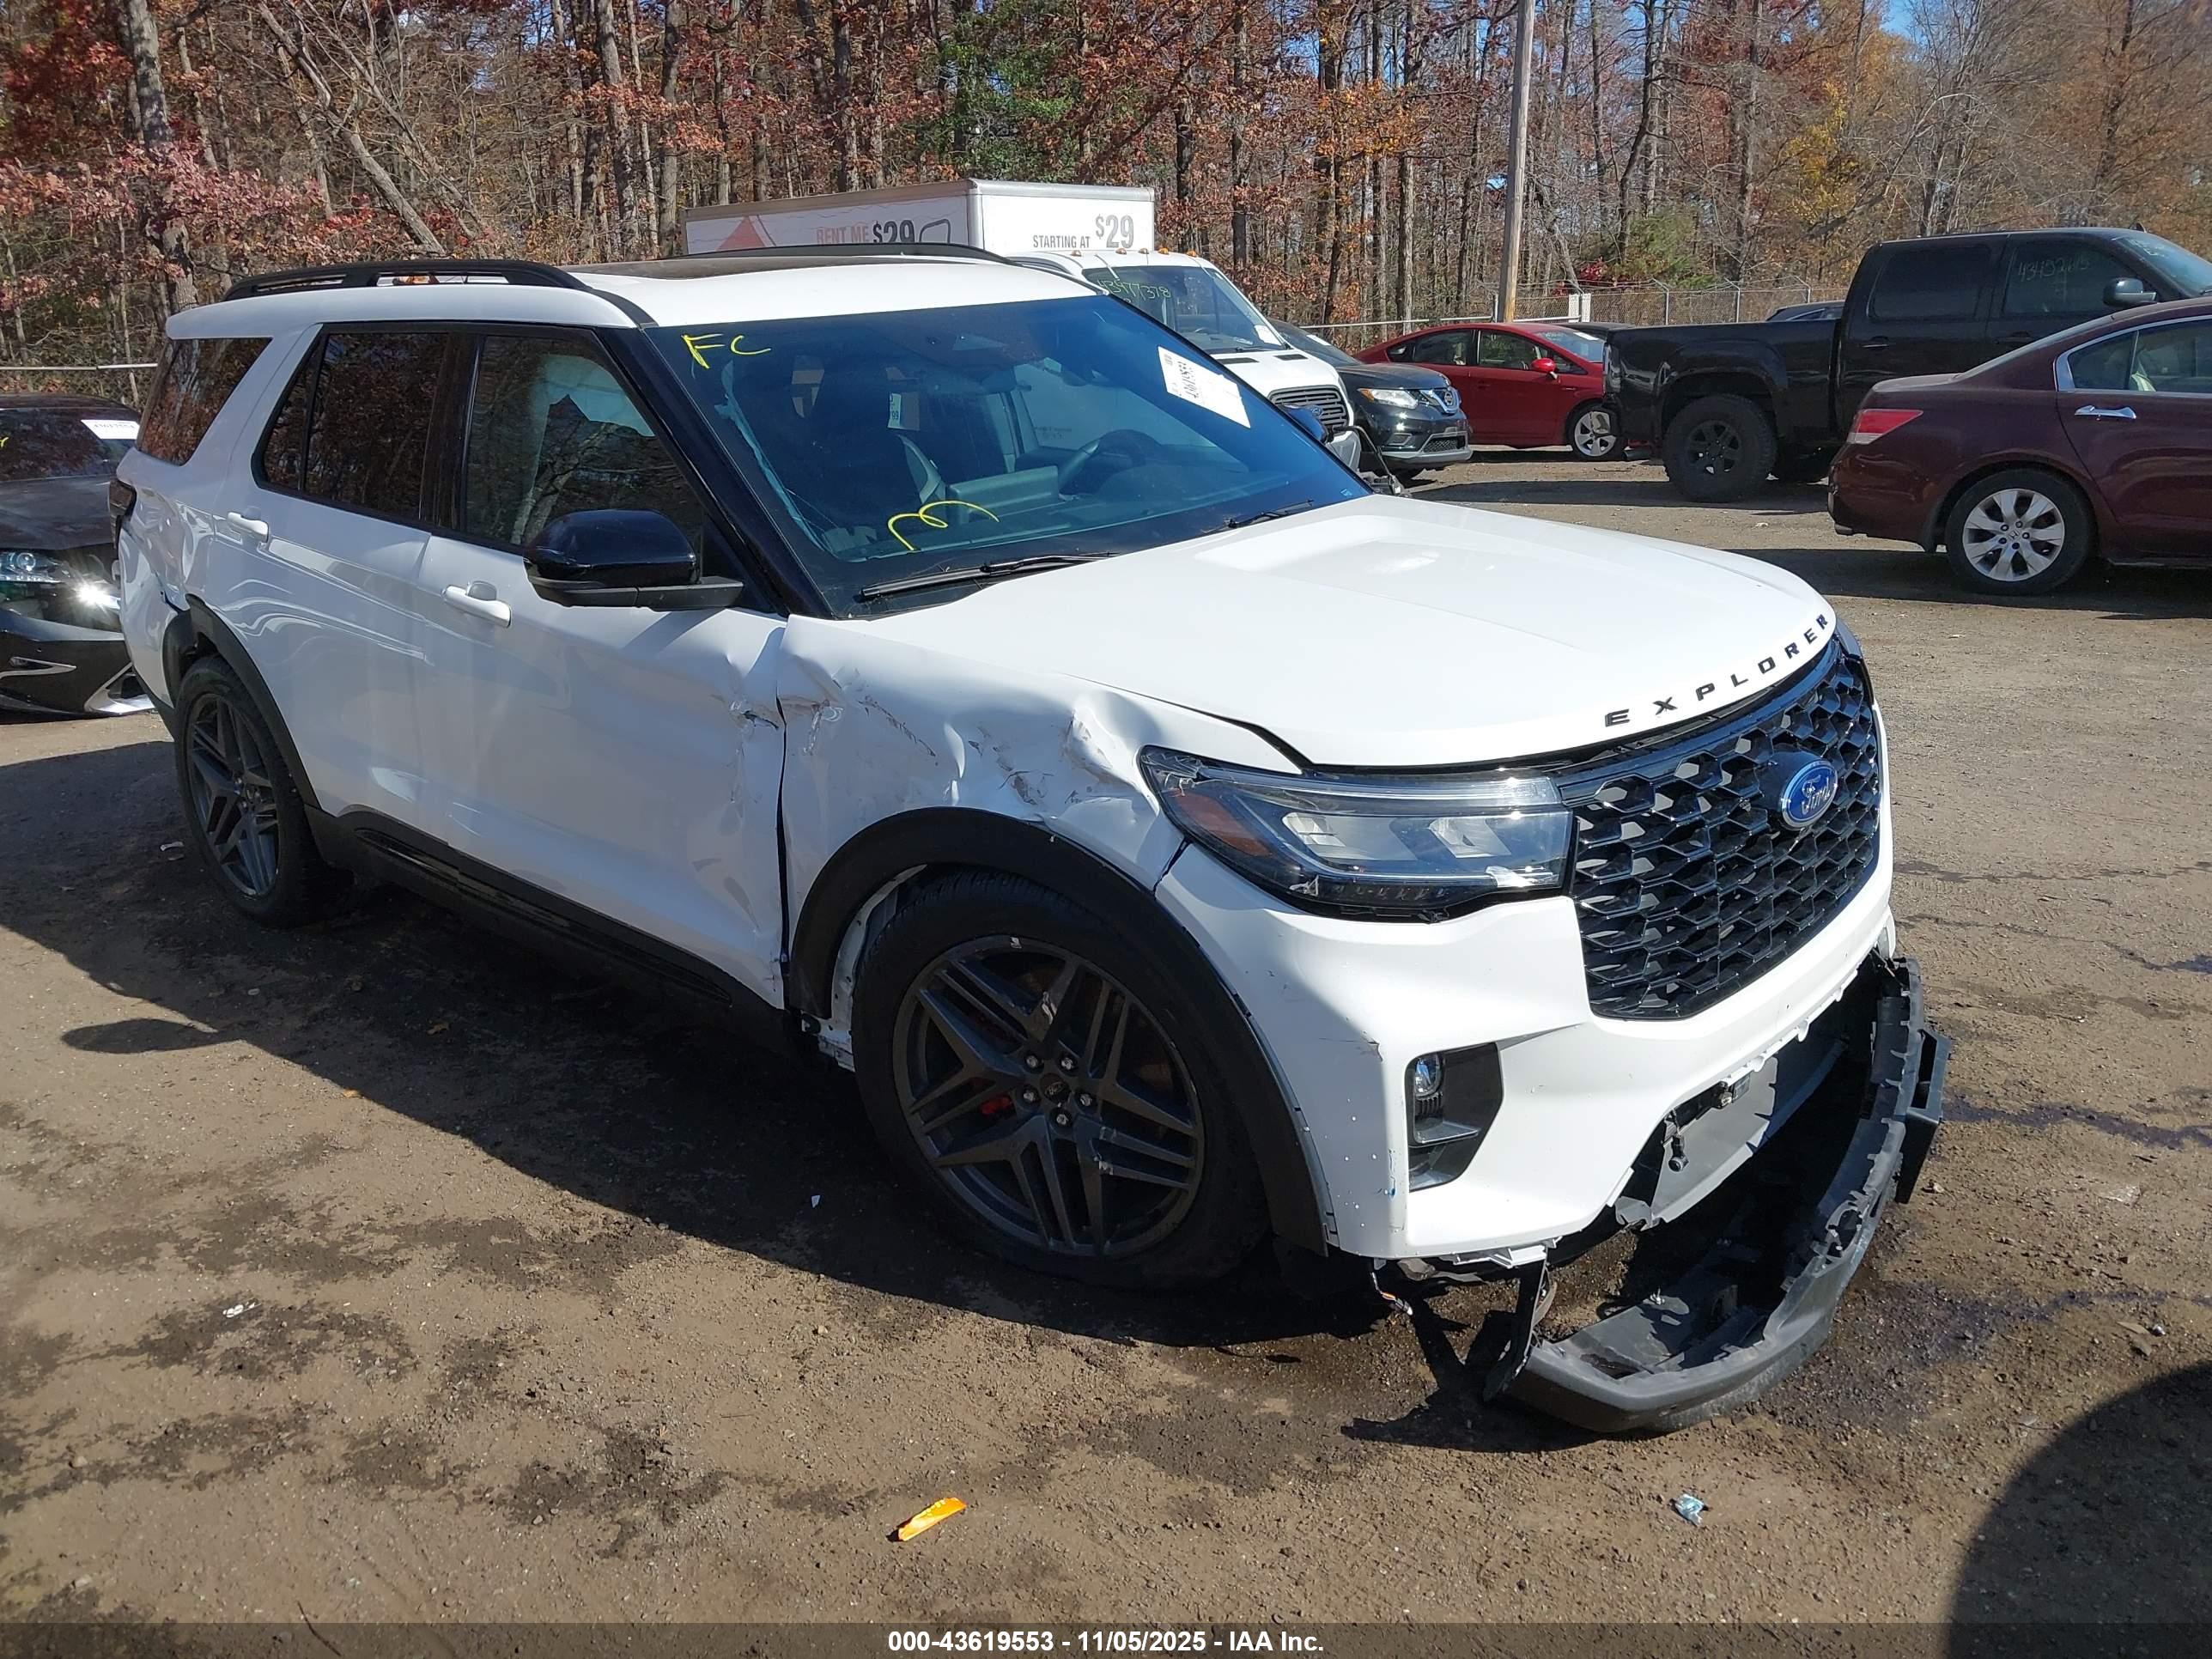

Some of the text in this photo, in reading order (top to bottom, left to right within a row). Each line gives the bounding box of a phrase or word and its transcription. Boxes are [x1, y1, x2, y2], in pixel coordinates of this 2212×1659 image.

[817, 220, 915, 244] RENT ME $29
[1033, 214, 1134, 249] STARTING AT $29
[1605, 614, 1829, 727] EXPLORER
